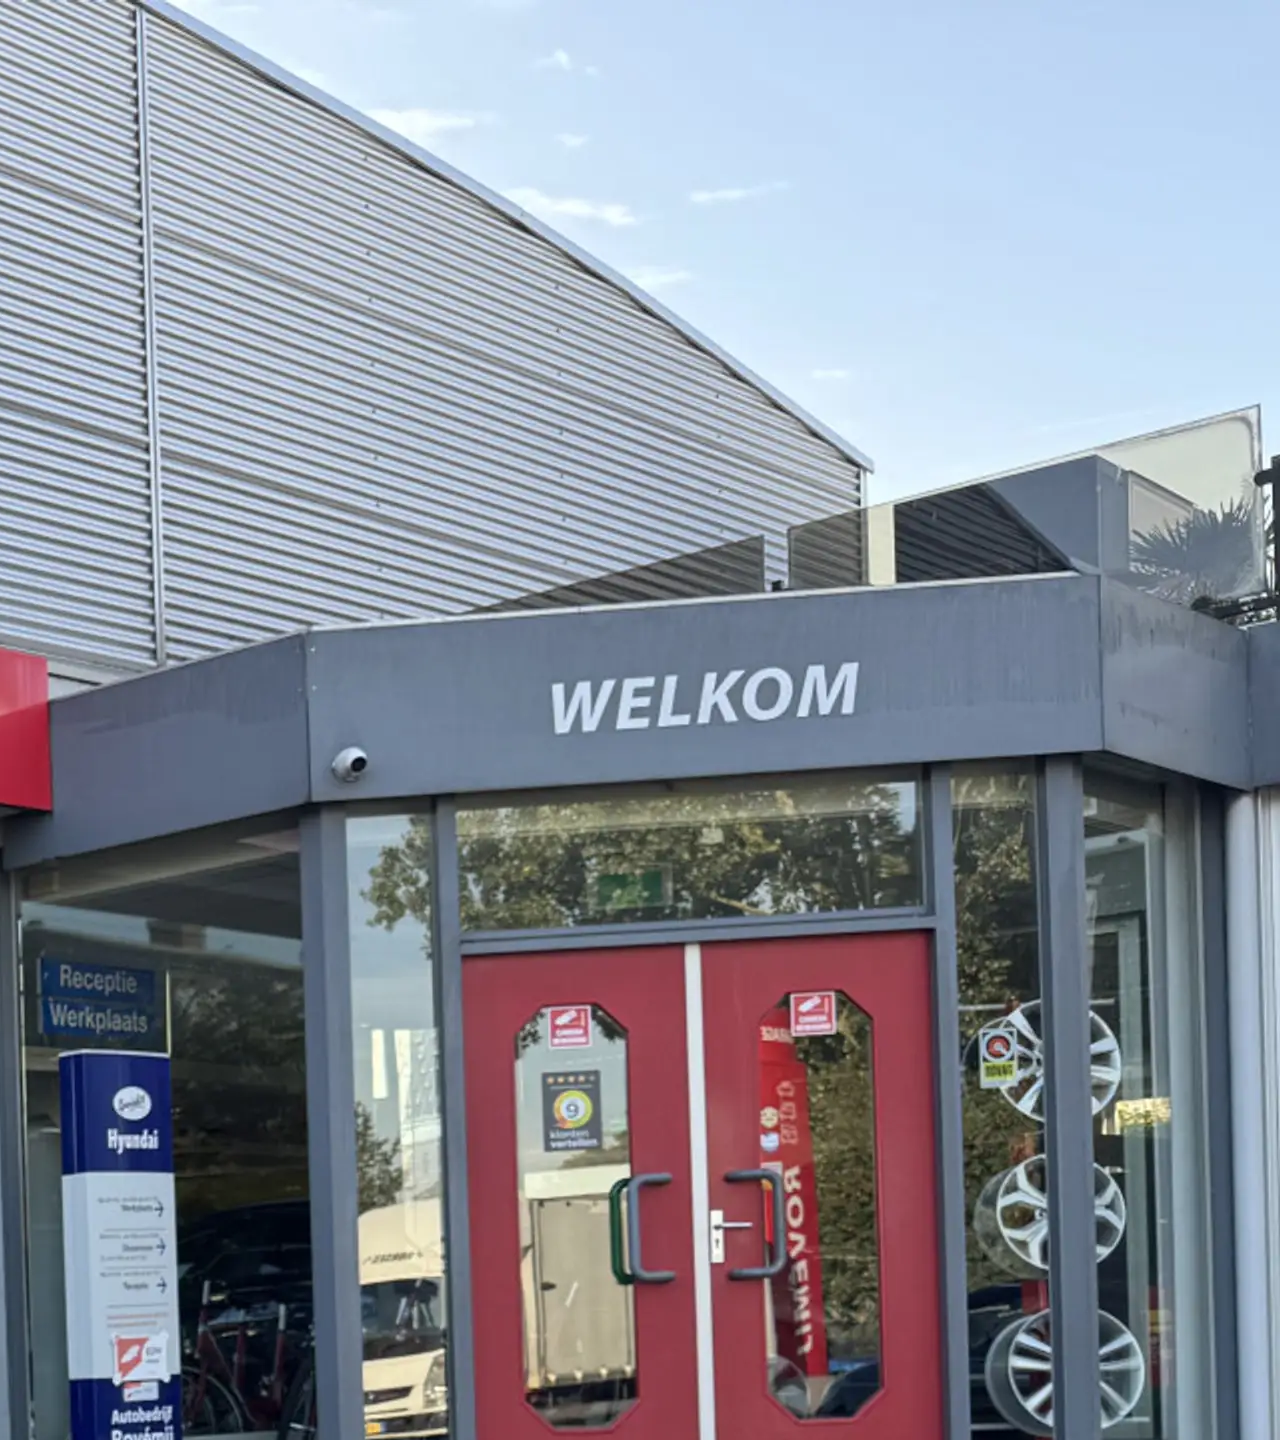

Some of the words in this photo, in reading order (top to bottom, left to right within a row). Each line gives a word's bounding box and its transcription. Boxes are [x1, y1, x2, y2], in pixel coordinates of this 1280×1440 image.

[551, 661, 860, 735] WELKOM
[59, 963, 138, 997] Receptie
[49, 1002, 148, 1035] Werkplaats
[107, 1128, 159, 1155] Hyundai
[111, 1405, 173, 1426] Autobedrijf
